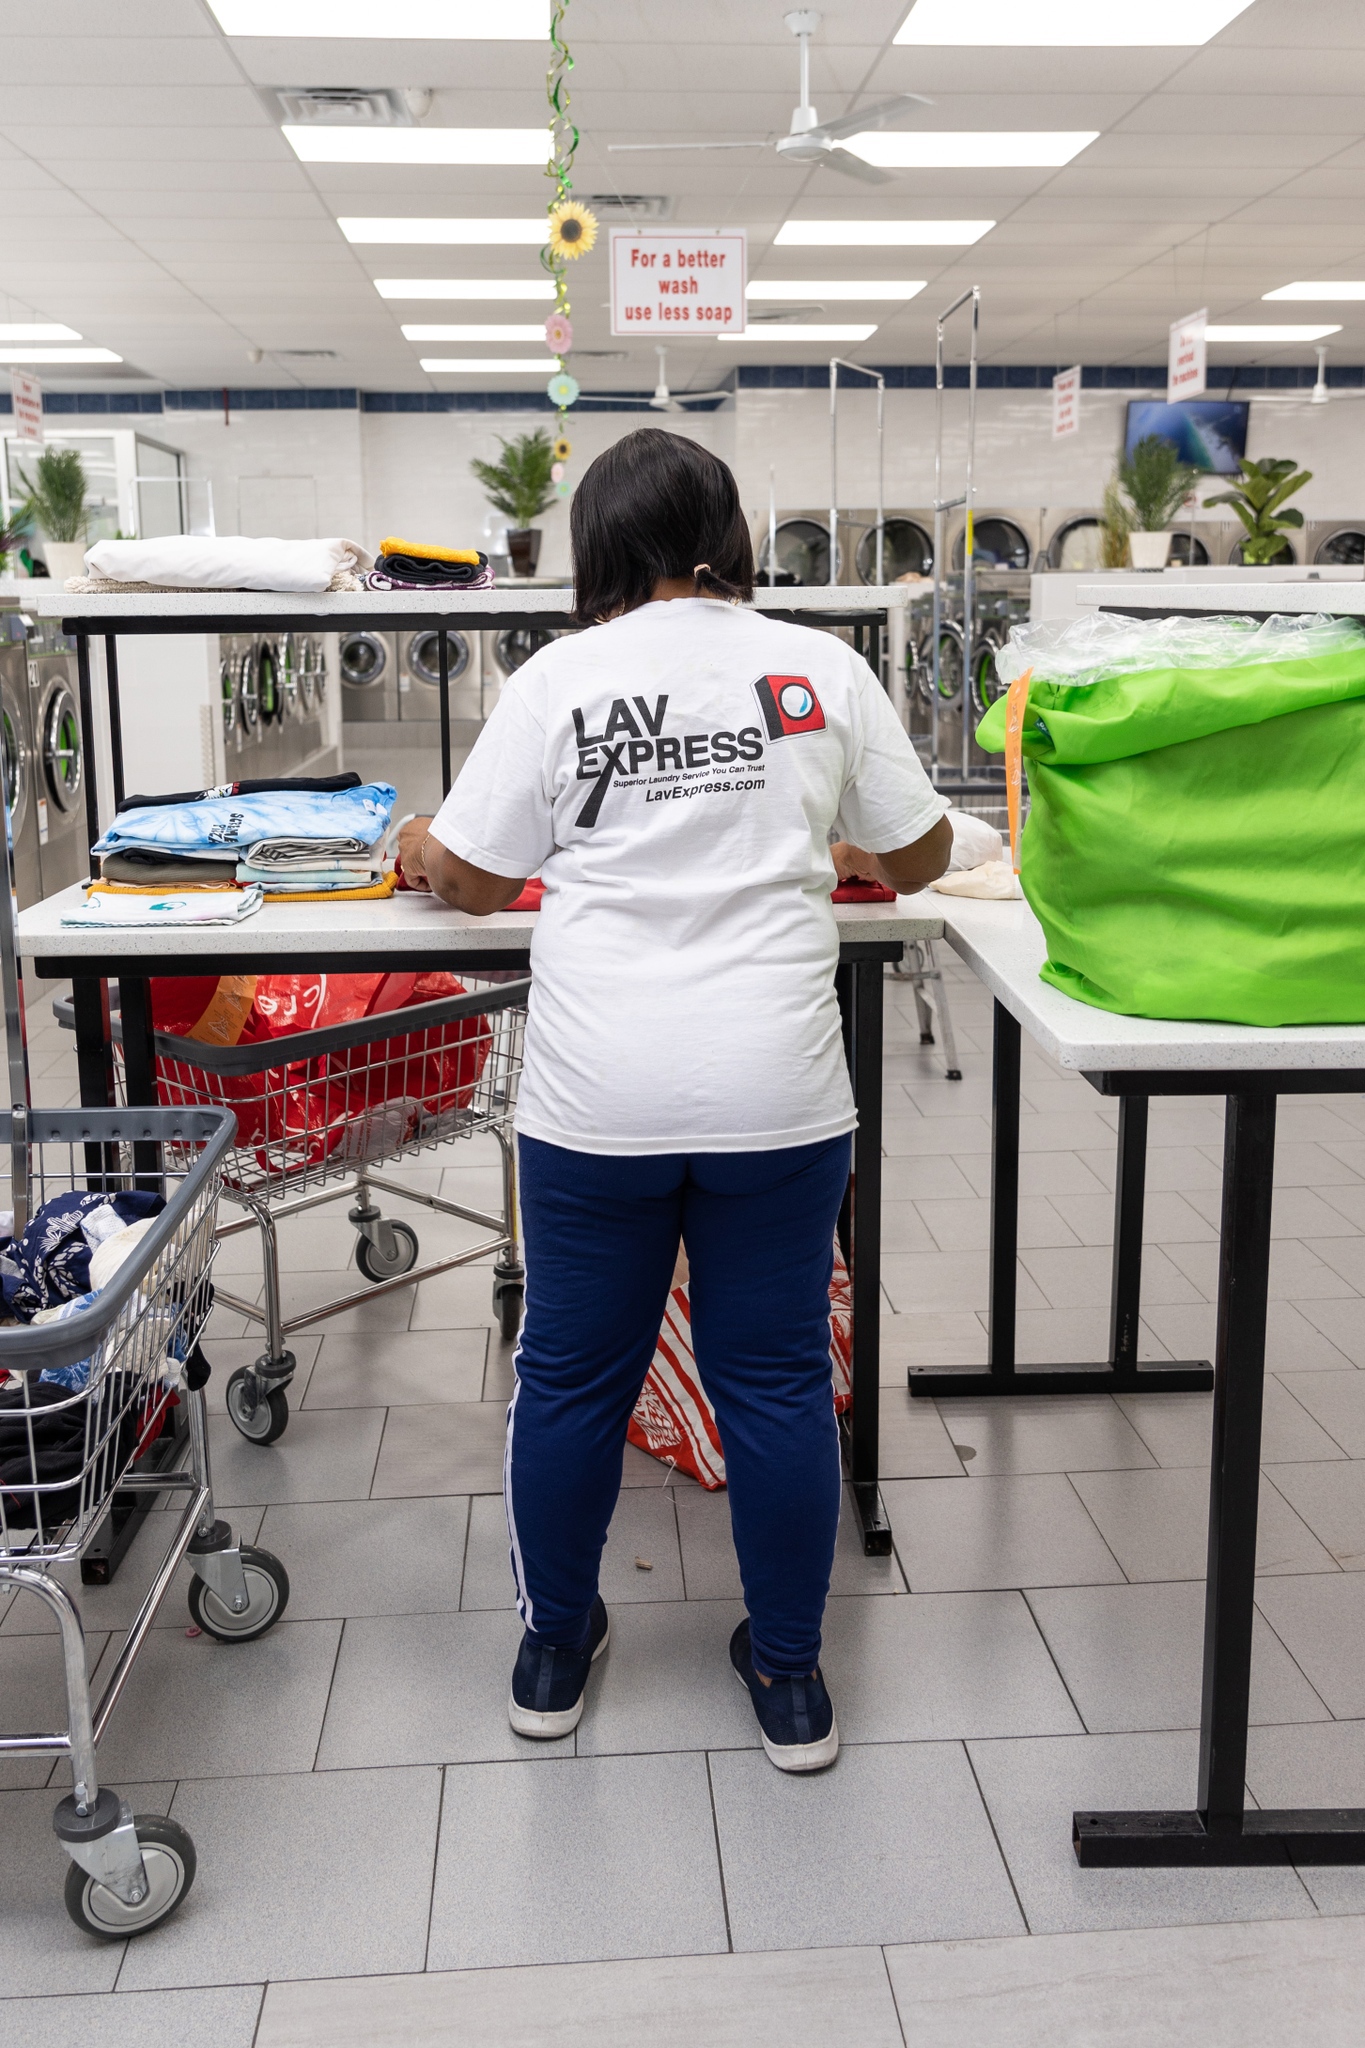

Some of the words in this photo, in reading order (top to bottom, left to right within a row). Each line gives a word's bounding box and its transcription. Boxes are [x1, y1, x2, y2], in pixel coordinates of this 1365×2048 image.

[630, 249, 656, 268] For
[662, 253, 671, 268] a
[677, 249, 726, 268] better
[658, 276, 698, 294] wash
[625, 306, 652, 320] use
[658, 302, 690, 320] less
[696, 306, 732, 324] soap
[572, 694, 669, 748] LAV
[574, 727, 763, 828] EXPRESS
[613, 777, 647, 788] Superior
[648, 774, 680, 785] Laundry
[682, 770, 710, 781] Service
[712, 766, 728, 775] You
[729, 765, 745, 773] Can
[747, 764, 765, 772] Trust
[645, 779, 765, 802] LavExpress.com
